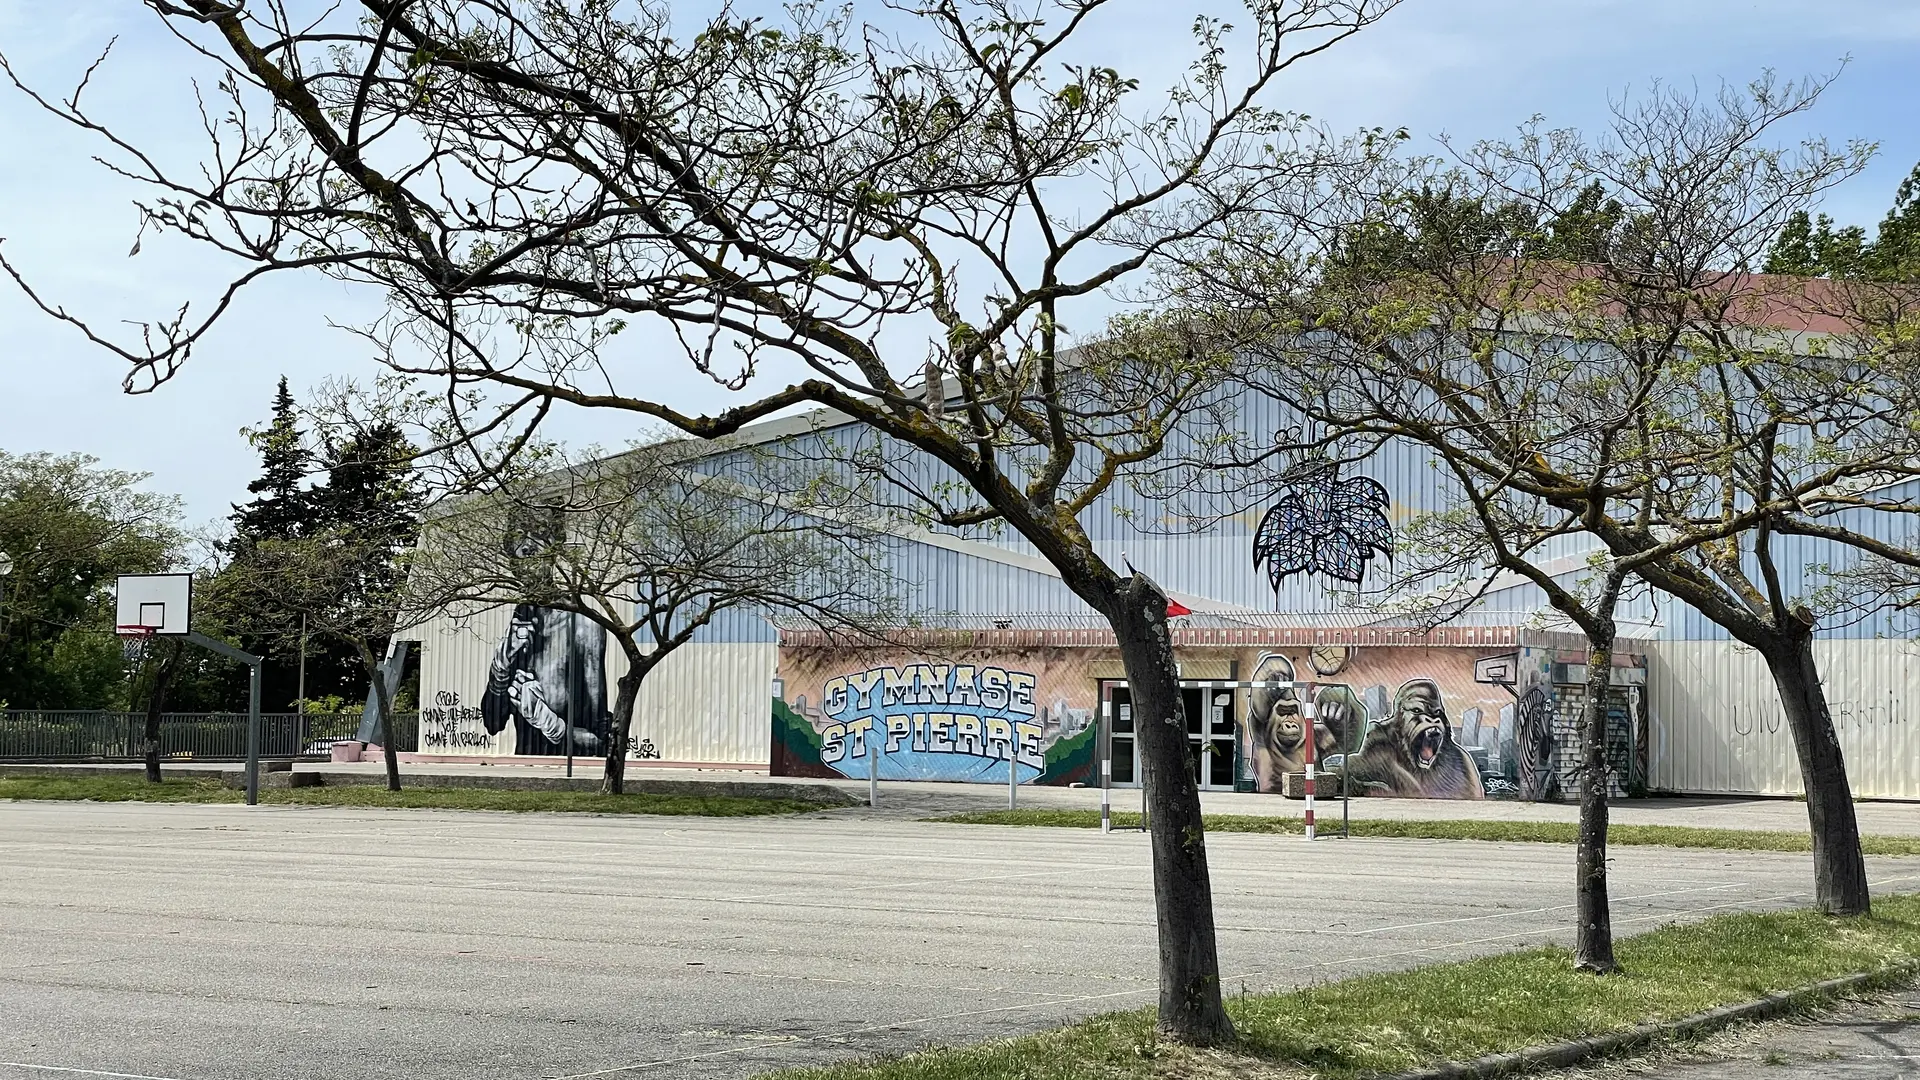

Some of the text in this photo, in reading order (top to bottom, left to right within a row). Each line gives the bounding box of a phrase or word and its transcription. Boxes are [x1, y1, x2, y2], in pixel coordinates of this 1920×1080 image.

[824, 663, 1036, 719] GYMNASE
[821, 712, 1045, 770] ST PIERRE
